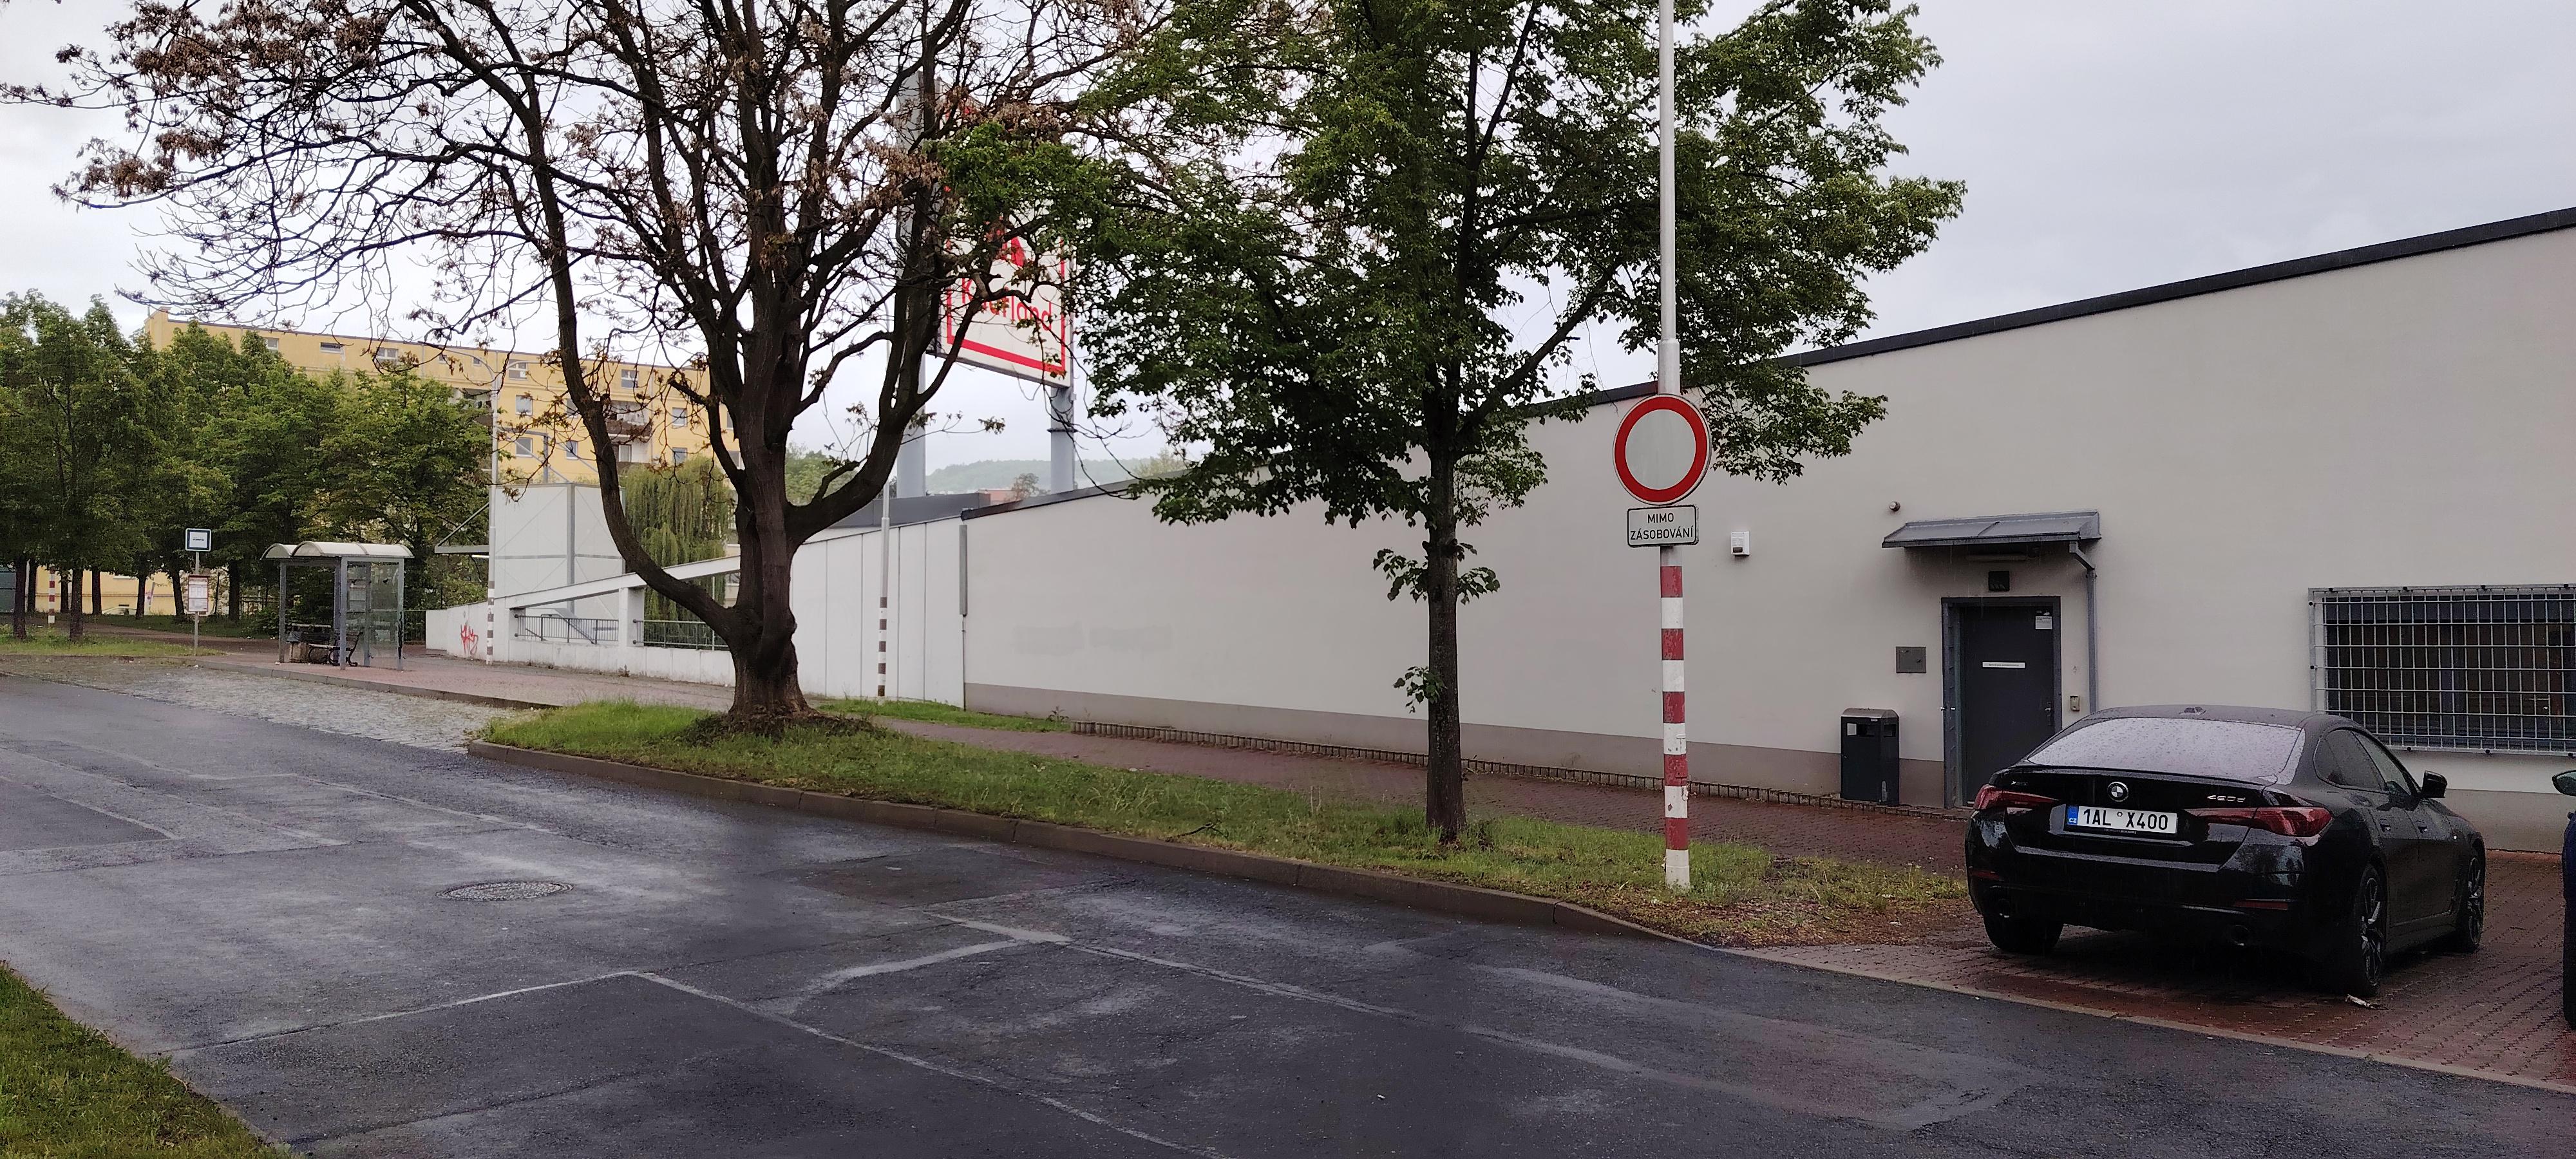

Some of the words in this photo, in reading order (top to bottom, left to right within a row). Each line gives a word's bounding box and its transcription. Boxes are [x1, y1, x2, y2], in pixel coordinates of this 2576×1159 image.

[961, 277, 1052, 331] Kufland
[1647, 513, 1674, 523] MIMO
[1630, 525, 1694, 540] ZÁSOBOVÁNÍ
[2083, 809, 2112, 826] 1AL
[2126, 811, 2168, 831] X400
